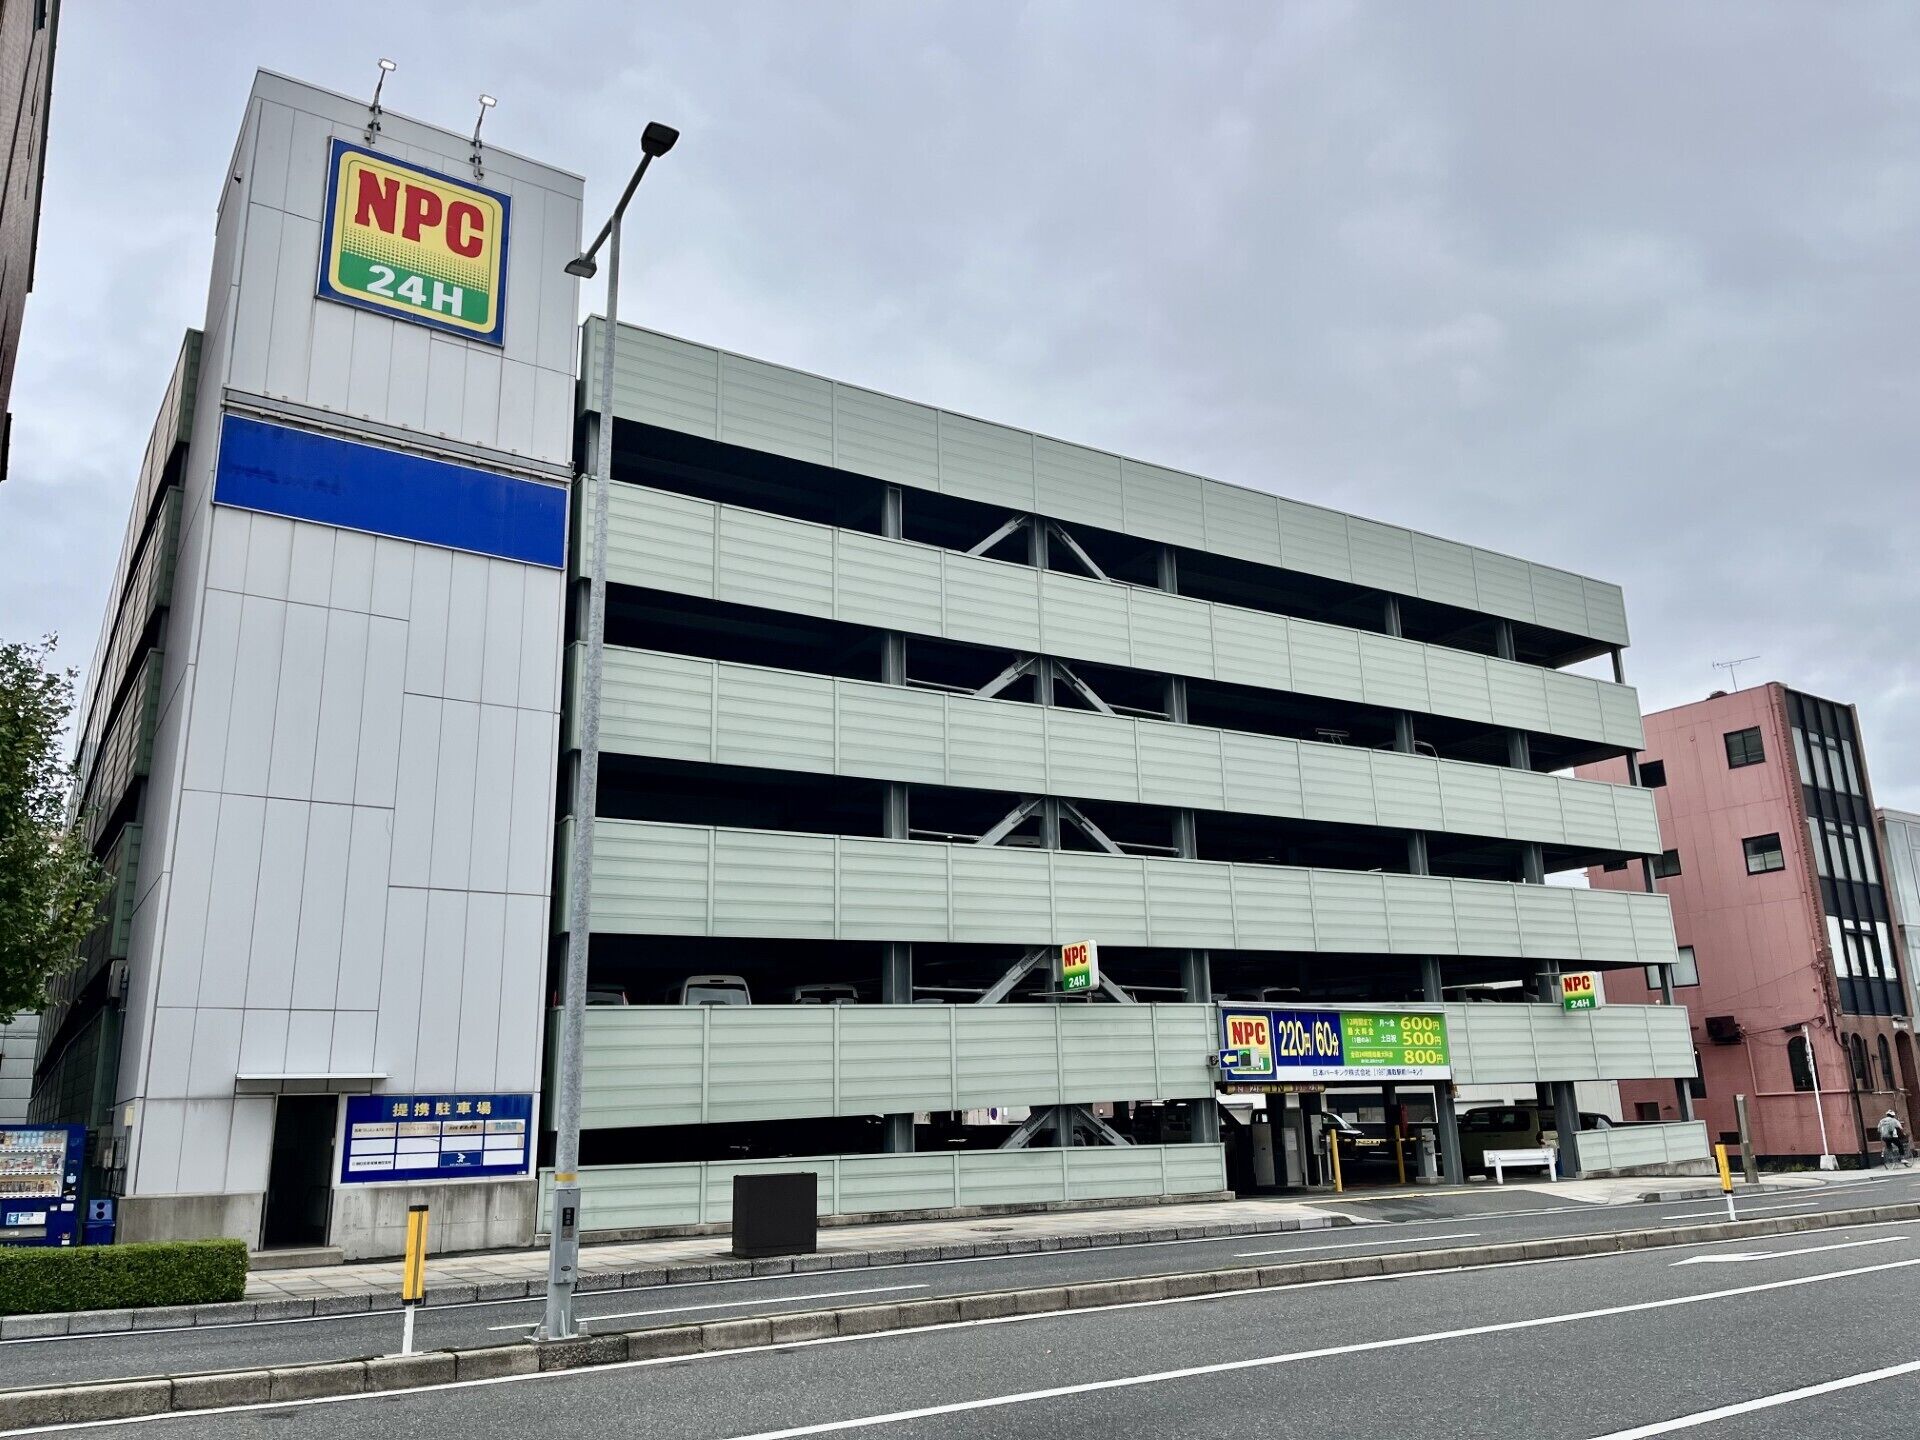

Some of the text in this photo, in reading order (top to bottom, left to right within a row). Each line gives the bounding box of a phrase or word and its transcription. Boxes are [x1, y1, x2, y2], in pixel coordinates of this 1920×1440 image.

[354, 168, 485, 259] NPC
[366, 264, 464, 317] 24H
[1063, 945, 1087, 967] NPC
[1068, 975, 1086, 988] 24H
[1563, 975, 1591, 992] NPC
[1570, 998, 1590, 1009] 24H
[1400, 1016, 1440, 1031] 600円
[1231, 1021, 1266, 1045] NPC
[1402, 1031, 1442, 1046] 500円
[1404, 1049, 1444, 1065] 800円
[1312, 1068, 1371, 1077] 日本パーキング株式会社
[392, 1101, 492, 1118] 提携駐車場
